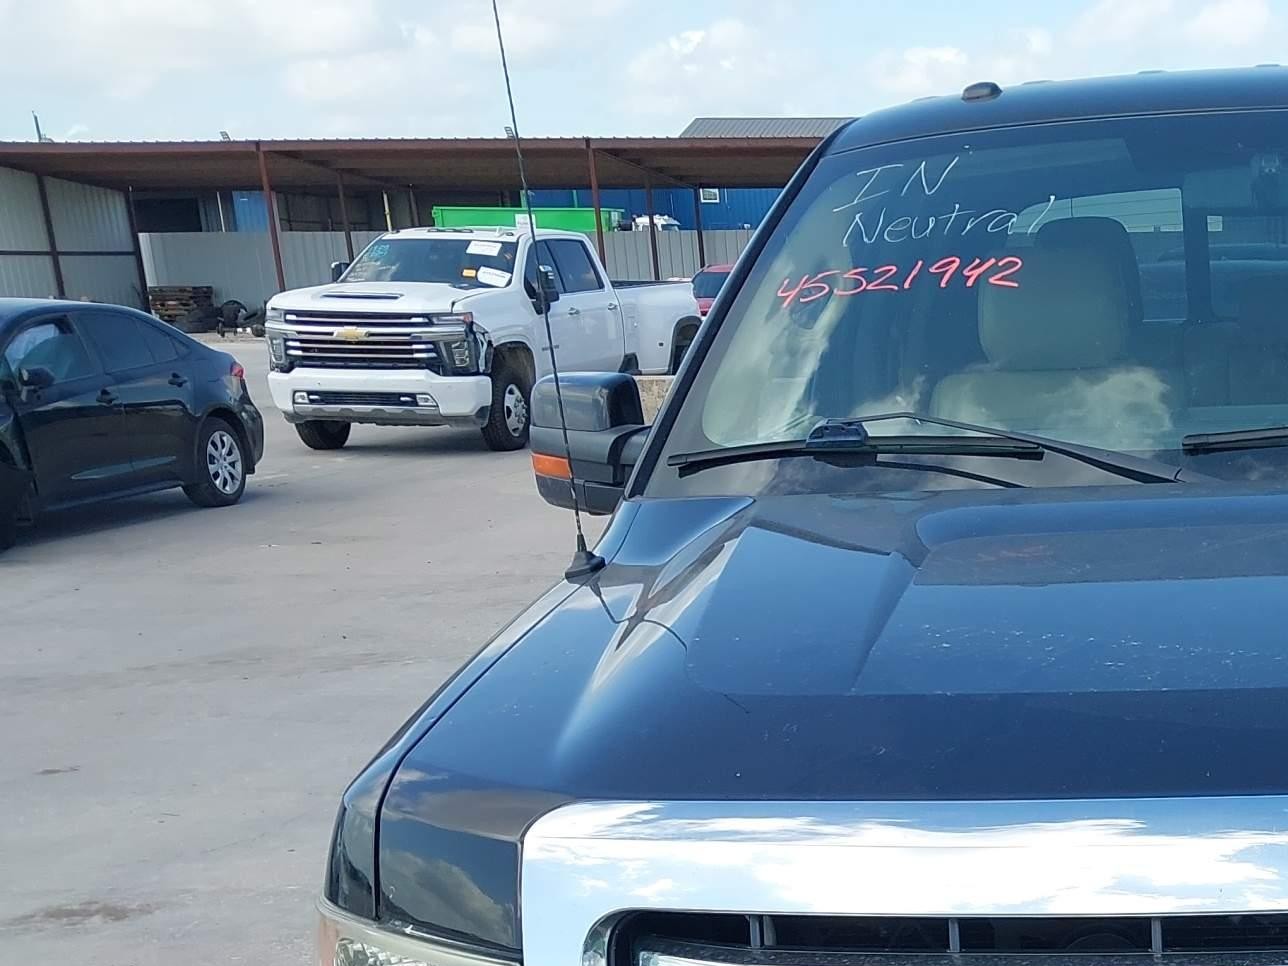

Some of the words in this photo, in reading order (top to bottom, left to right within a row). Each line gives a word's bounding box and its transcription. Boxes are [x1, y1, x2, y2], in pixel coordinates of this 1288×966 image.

[832, 155, 960, 213] IN
[842, 194, 1056, 248] Neutral
[776, 256, 1023, 309] 45521942
